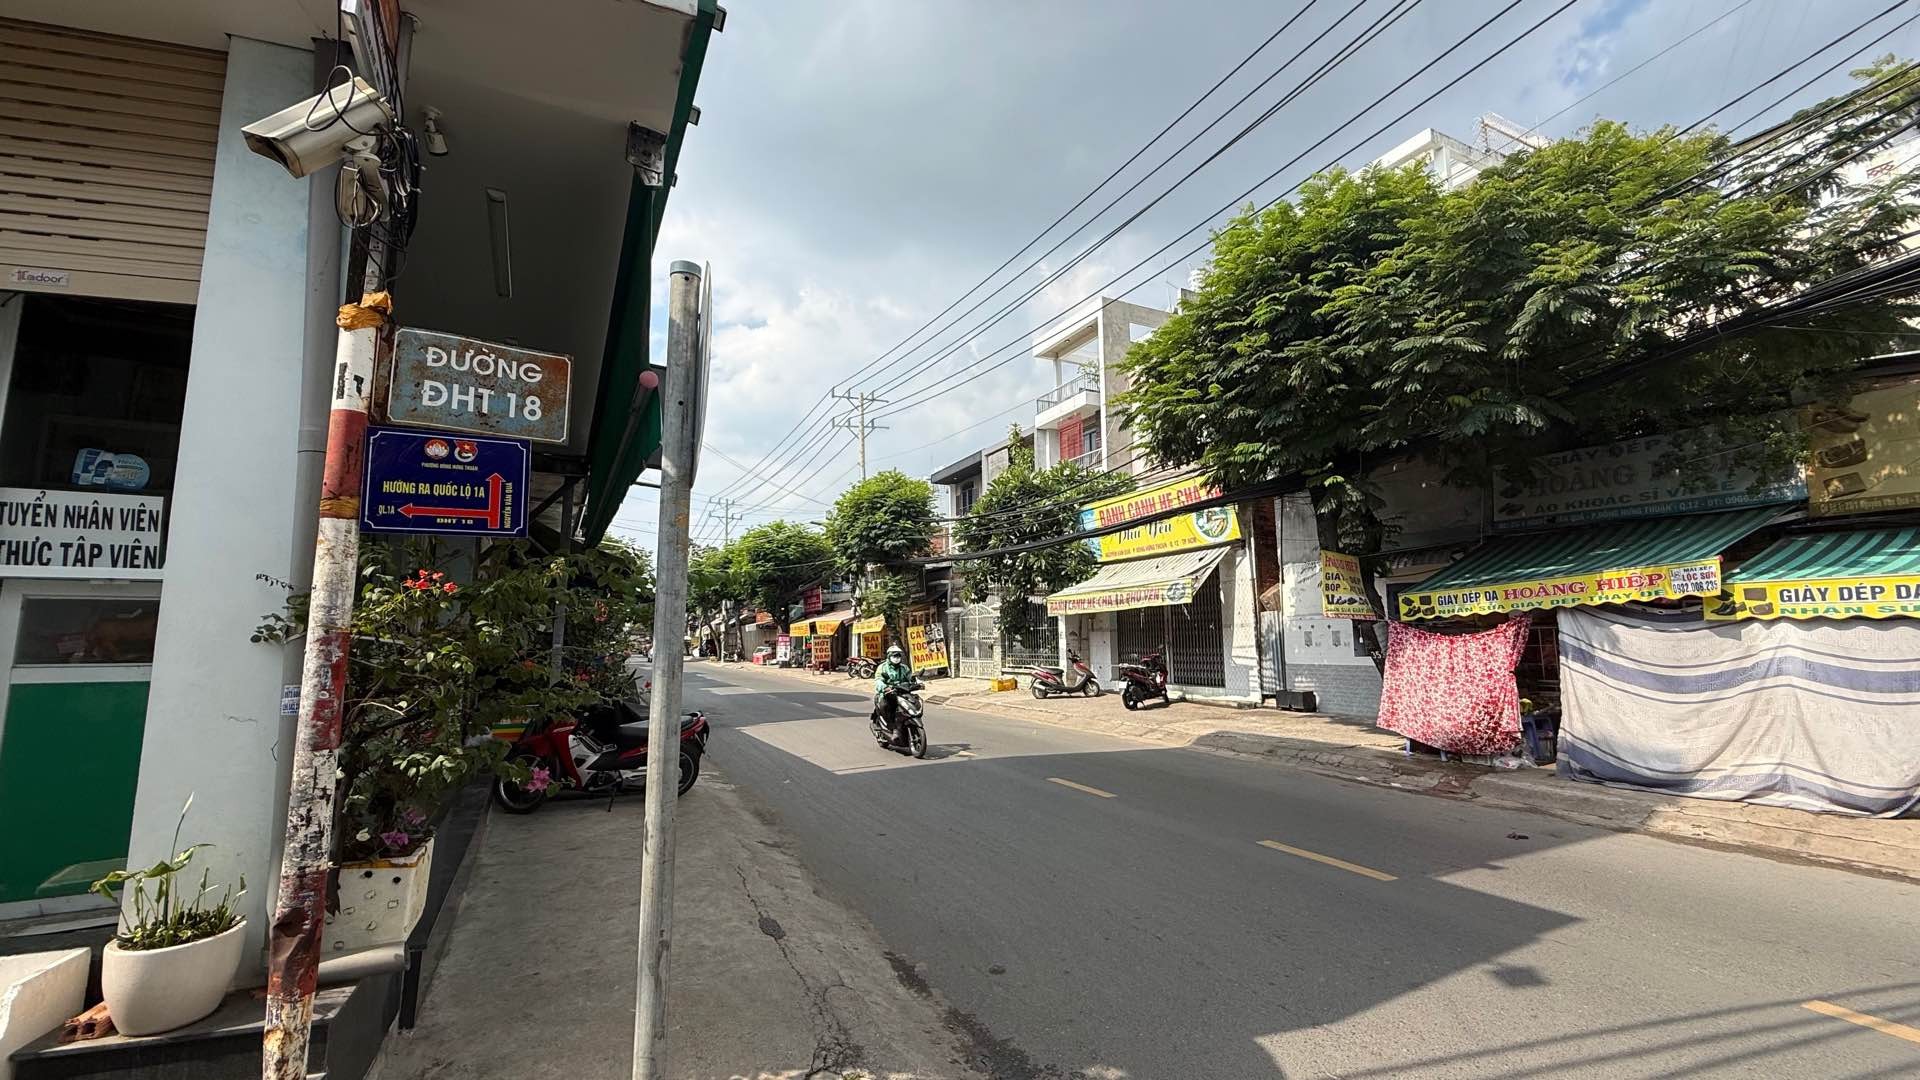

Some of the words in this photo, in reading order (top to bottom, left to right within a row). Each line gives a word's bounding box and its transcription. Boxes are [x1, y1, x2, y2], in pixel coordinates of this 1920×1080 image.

[425, 346, 543, 383] ĐƯỜNG
[421, 379, 495, 414] ĐHT
[507, 392, 542, 421] 18
[382, 479, 416, 494] HƯỚNG
[418, 484, 431, 495] RA
[433, 480, 458, 497] QUỐC
[460, 483, 472, 500] LỘ
[474, 486, 485, 499] 1A
[0, 491, 57, 527] TUYỂN
[63, 500, 114, 531] NHÂN
[119, 502, 160, 532] VIÊN
[378, 504, 395, 516] QL.1A
[110, 538, 158, 569] VIÊN
[1484, 590, 1499, 601] DA
[1503, 582, 1587, 600] HOÀNG
[1779, 584, 1829, 603] GIÀY
[1838, 582, 1885, 601] DÉP
[914, 652, 934, 663] NAM
